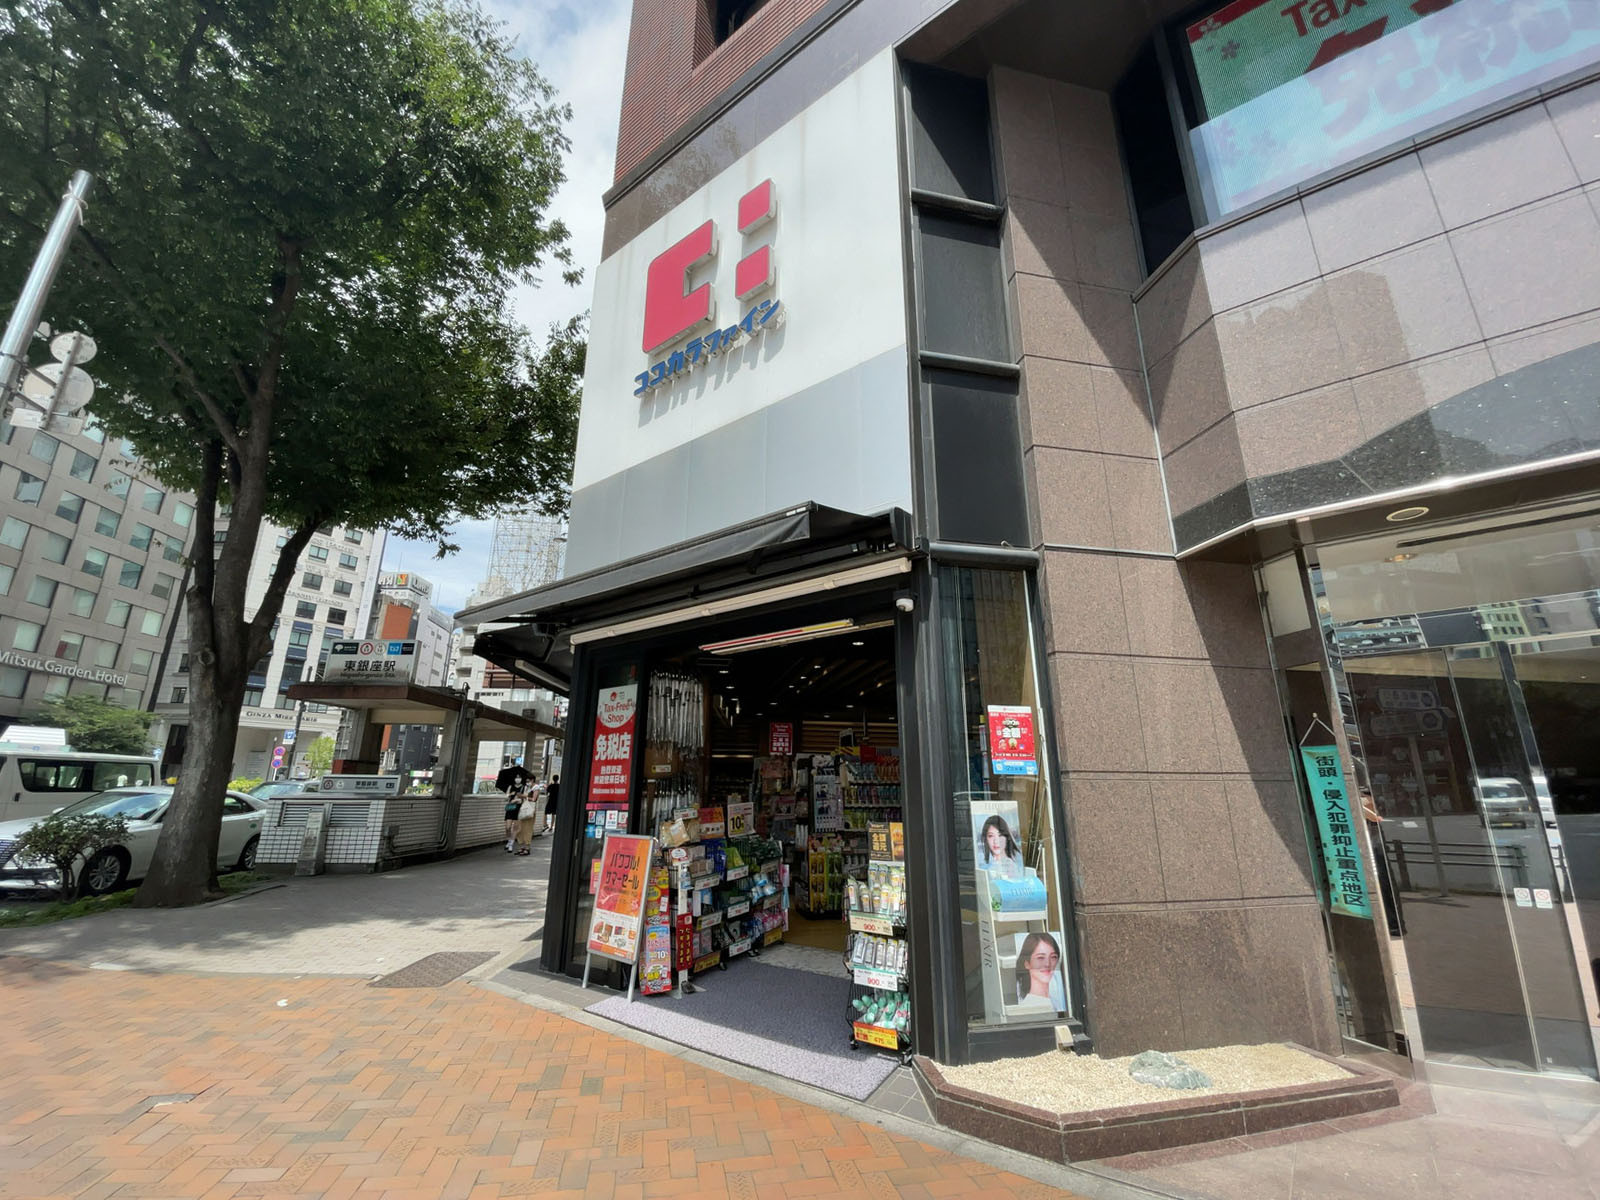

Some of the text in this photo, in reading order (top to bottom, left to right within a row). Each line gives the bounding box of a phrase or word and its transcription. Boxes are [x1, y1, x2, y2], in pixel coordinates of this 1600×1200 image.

[633, 299, 783, 397] ココカラファイン
[0, 650, 128, 686] Mitsui Garden Hotel
[343, 660, 396, 672] 東銀座駅
[246, 711, 272, 719] GINZA
[607, 713, 625, 724] Shop
[595, 732, 632, 761] 免税店
[1315, 755, 1365, 907] 街頭・侵入犯罪抑止重点地区
[605, 871, 640, 890] サマーセール
